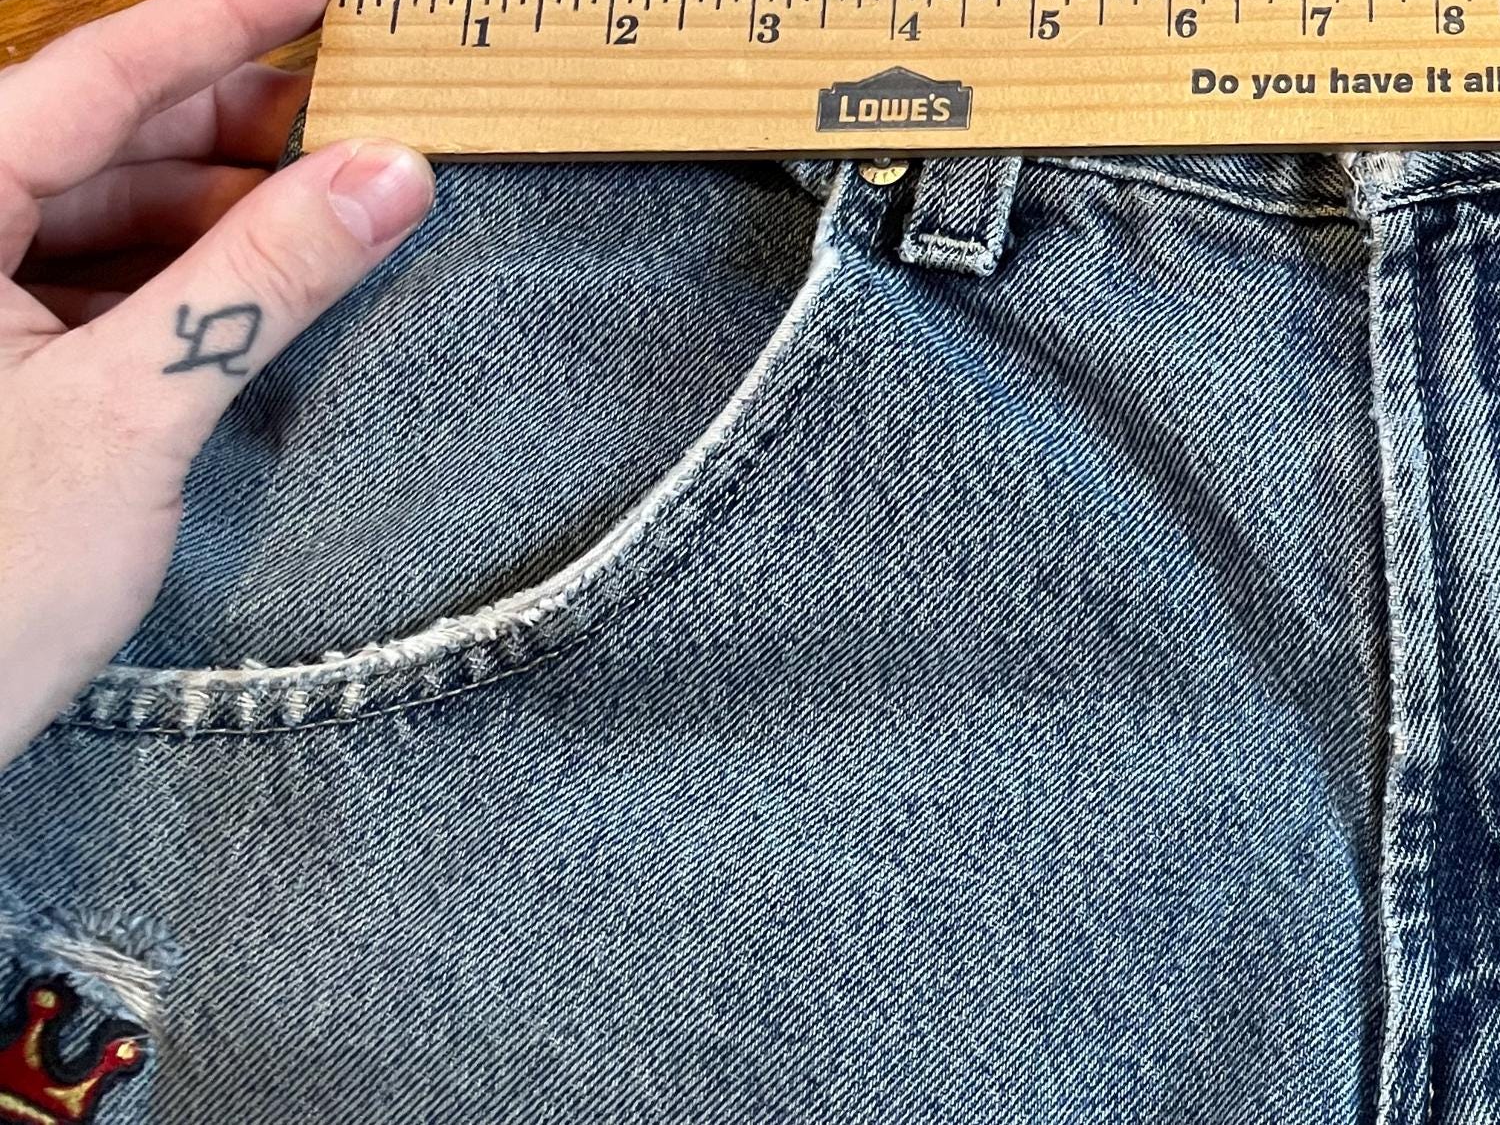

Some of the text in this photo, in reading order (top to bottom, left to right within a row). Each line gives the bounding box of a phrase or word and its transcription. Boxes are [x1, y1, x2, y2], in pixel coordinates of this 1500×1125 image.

[473, 17, 491, 47] 1
[614, 16, 639, 45] 2
[757, 13, 781, 44] 3
[898, 12, 922, 41] 4
[1038, 11, 1060, 40] 5
[1174, 9, 1197, 38] 6
[1310, 7, 1332, 37] 7
[1443, 5, 1465, 35] 8
[1191, 69, 1239, 94] Do
[1251, 74, 1316, 100] you
[1330, 67, 1414, 94] have
[1426, 66, 1452, 93] it
[837, 92, 953, 122] LOWE'S
